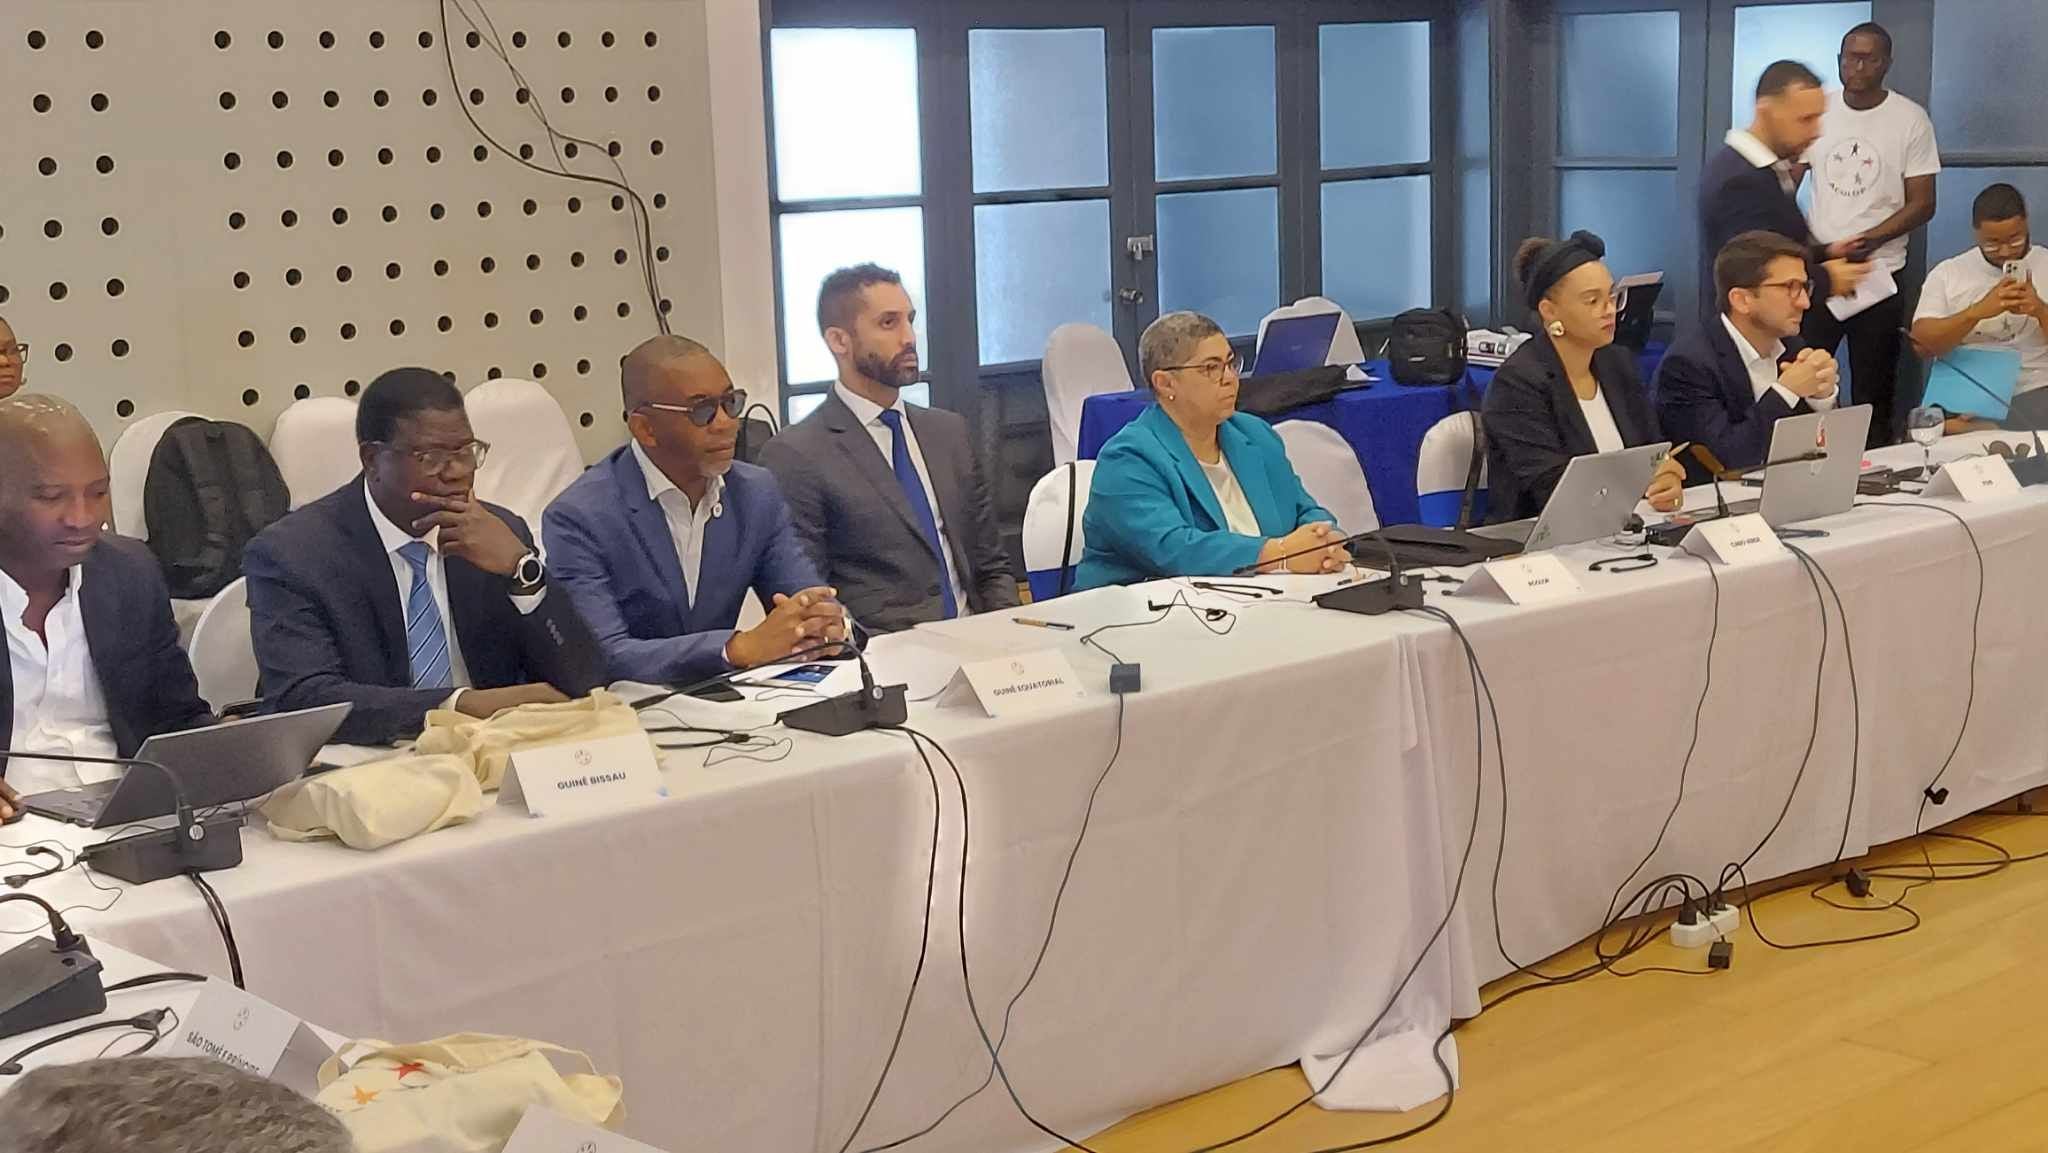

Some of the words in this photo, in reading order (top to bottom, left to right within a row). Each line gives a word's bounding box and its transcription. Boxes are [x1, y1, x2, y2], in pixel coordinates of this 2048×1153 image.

[557, 775, 589, 790] GUINÉ
[590, 771, 627, 785] BISSAU
[186, 1030, 204, 1048] SÃO
[202, 1038, 225, 1058] TOMÉ
